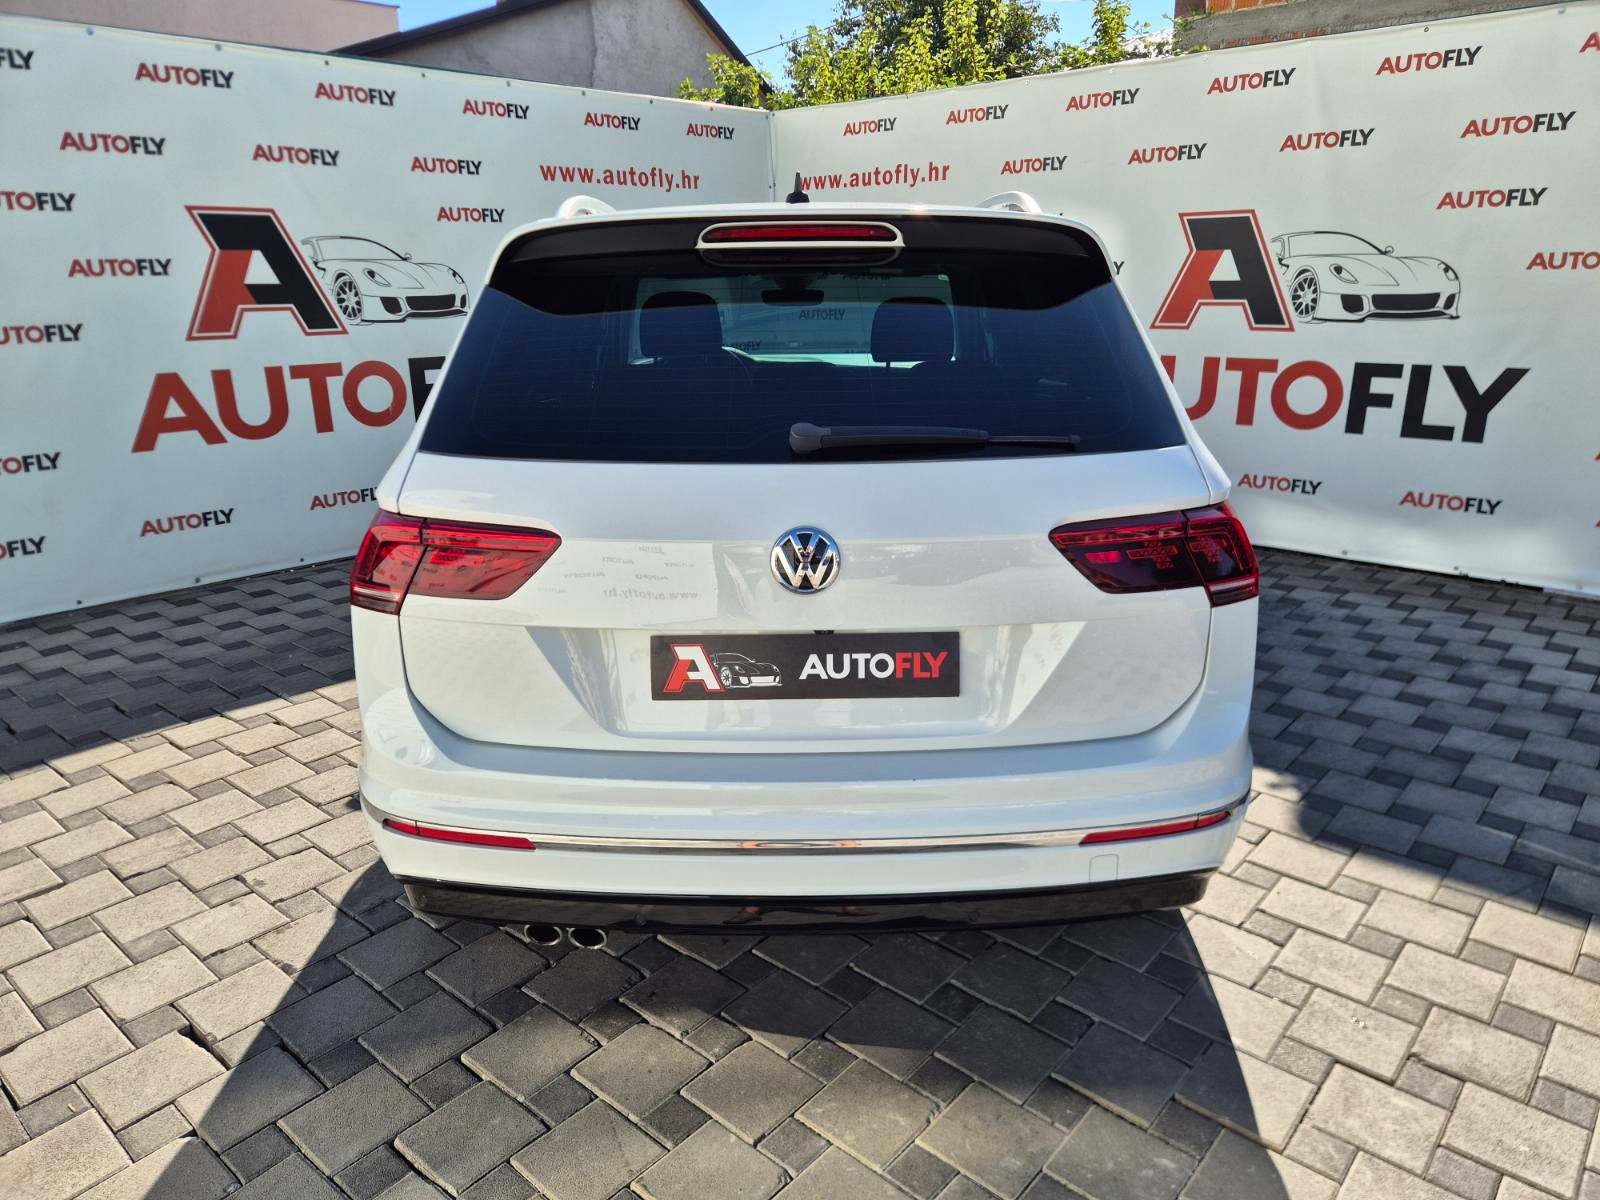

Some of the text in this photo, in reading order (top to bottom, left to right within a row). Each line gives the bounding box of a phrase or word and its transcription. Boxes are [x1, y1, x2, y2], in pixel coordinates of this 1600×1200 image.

[1375, 45, 1484, 76] AUTOFLY
[134, 62, 234, 89] AUTOFLY
[1206, 67, 1297, 95] AUTOFLY
[314, 82, 397, 106] AUTOFLY
[1065, 87, 1141, 112] AUTOFLY
[461, 98, 530, 120] AUTOFLY
[583, 111, 641, 131] AUTOFLY
[945, 103, 1010, 126] AUTOFLY
[686, 122, 735, 140] AUTOFLY
[842, 116, 898, 137] AUTOFLY
[1459, 110, 1577, 139] AUTOFLY
[59, 131, 166, 156] AUTOFLY
[1278, 127, 1376, 153] AUTOFLY
[251, 143, 340, 167] AUTOFLY
[1000, 155, 1068, 176] AUTOFLY
[1127, 142, 1208, 165] AUTOFLY
[410, 156, 483, 176] AUTOFLY
[539, 164, 700, 192] www.autofly.hr
[800, 161, 950, 190] www.autofly.hr
[0, 190, 76, 212] TOFLY
[1435, 186, 1548, 210] AUTOFLY
[436, 206, 505, 223] AUTOFLY
[67, 258, 172, 278] AUTOFLY
[799, 309, 846, 321] AUTOFLY
[130, 356, 446, 454] AUTOF
[1160, 354, 1532, 444] UTOFLY
[0, 451, 61, 475] OFLY
[1237, 473, 1323, 496] AUTOFLY
[309, 486, 378, 511] AUTOFL
[1399, 490, 1503, 516] AUTOFLY
[139, 507, 235, 537] AUTOFLY
[798, 651, 948, 680] AUTOFLY
